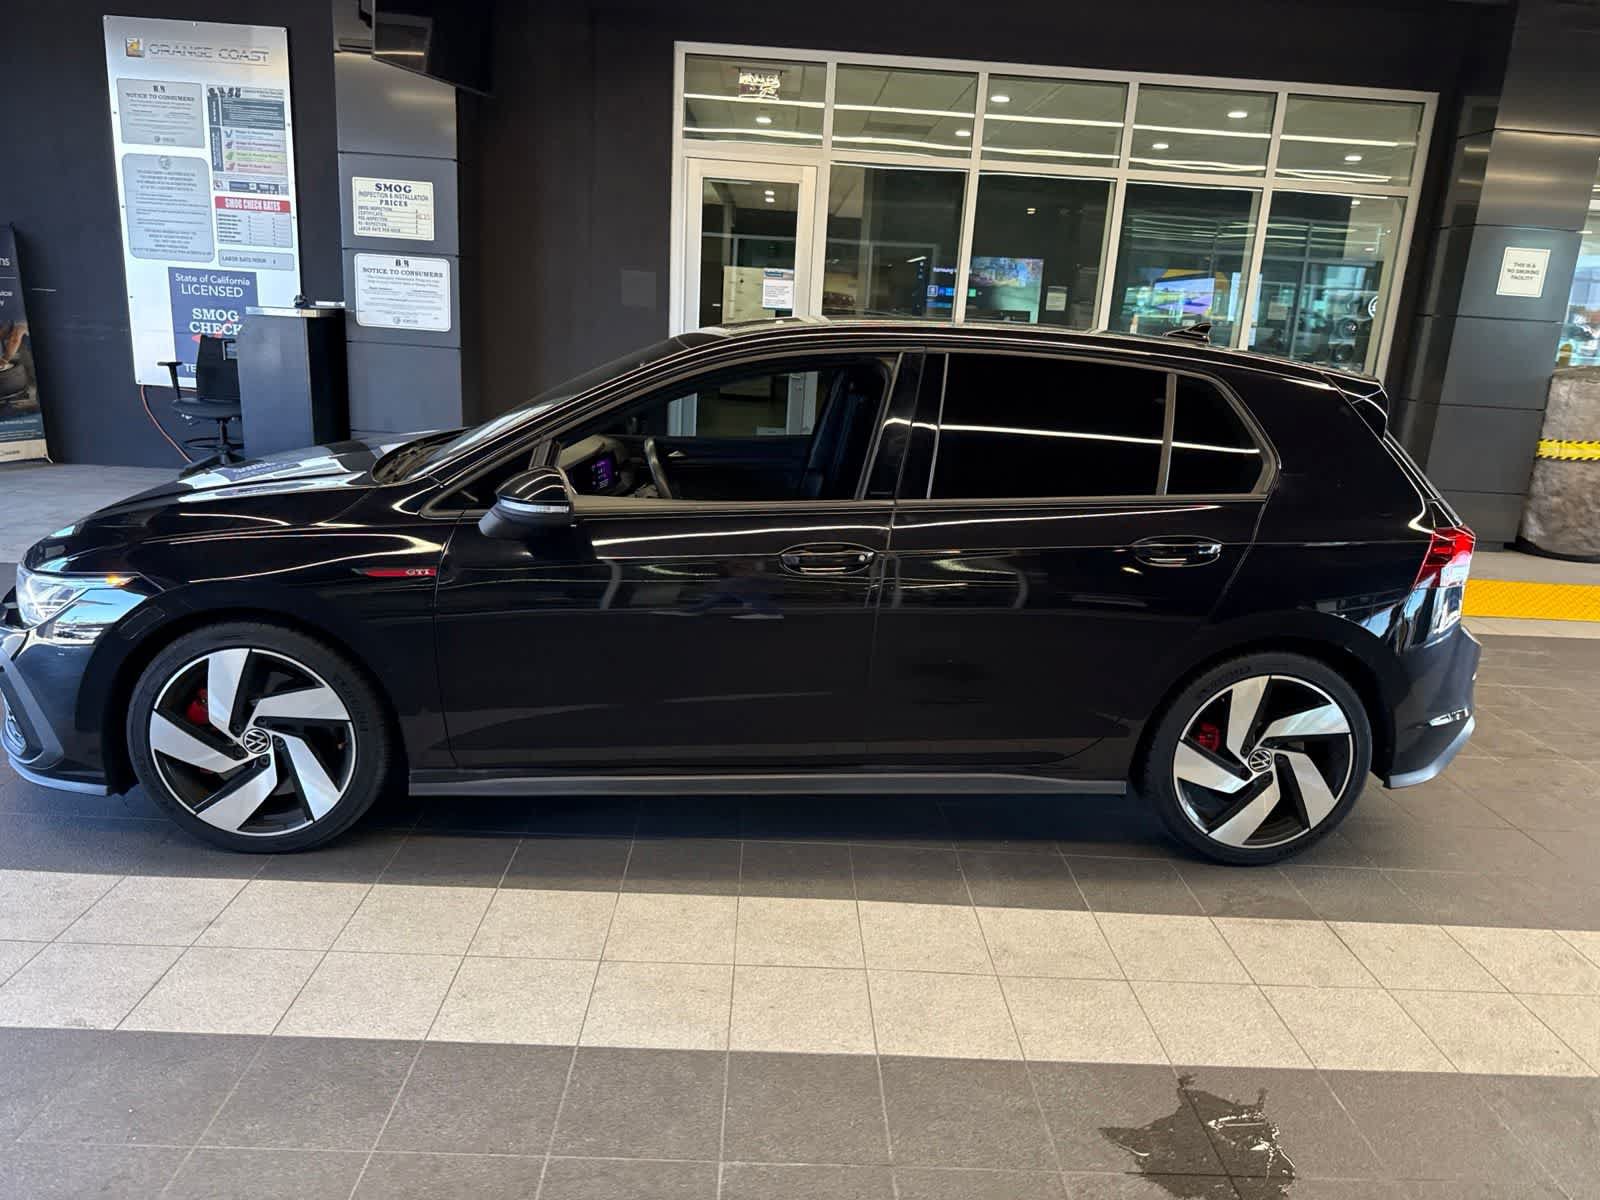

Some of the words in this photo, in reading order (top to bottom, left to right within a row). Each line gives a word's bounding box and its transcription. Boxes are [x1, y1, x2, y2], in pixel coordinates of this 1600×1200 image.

[149, 43, 213, 58] ORANGE
[219, 48, 269, 62] COAST
[375, 183, 412, 193] SMOG
[362, 267, 388, 275] NOTICE
[401, 270, 443, 278] CONSUMERS
[175, 273, 198, 282] State
[199, 274, 208, 283] of
[210, 275, 250, 286] California
[181, 284, 243, 297] LICENSED
[192, 308, 240, 321] SMOG
